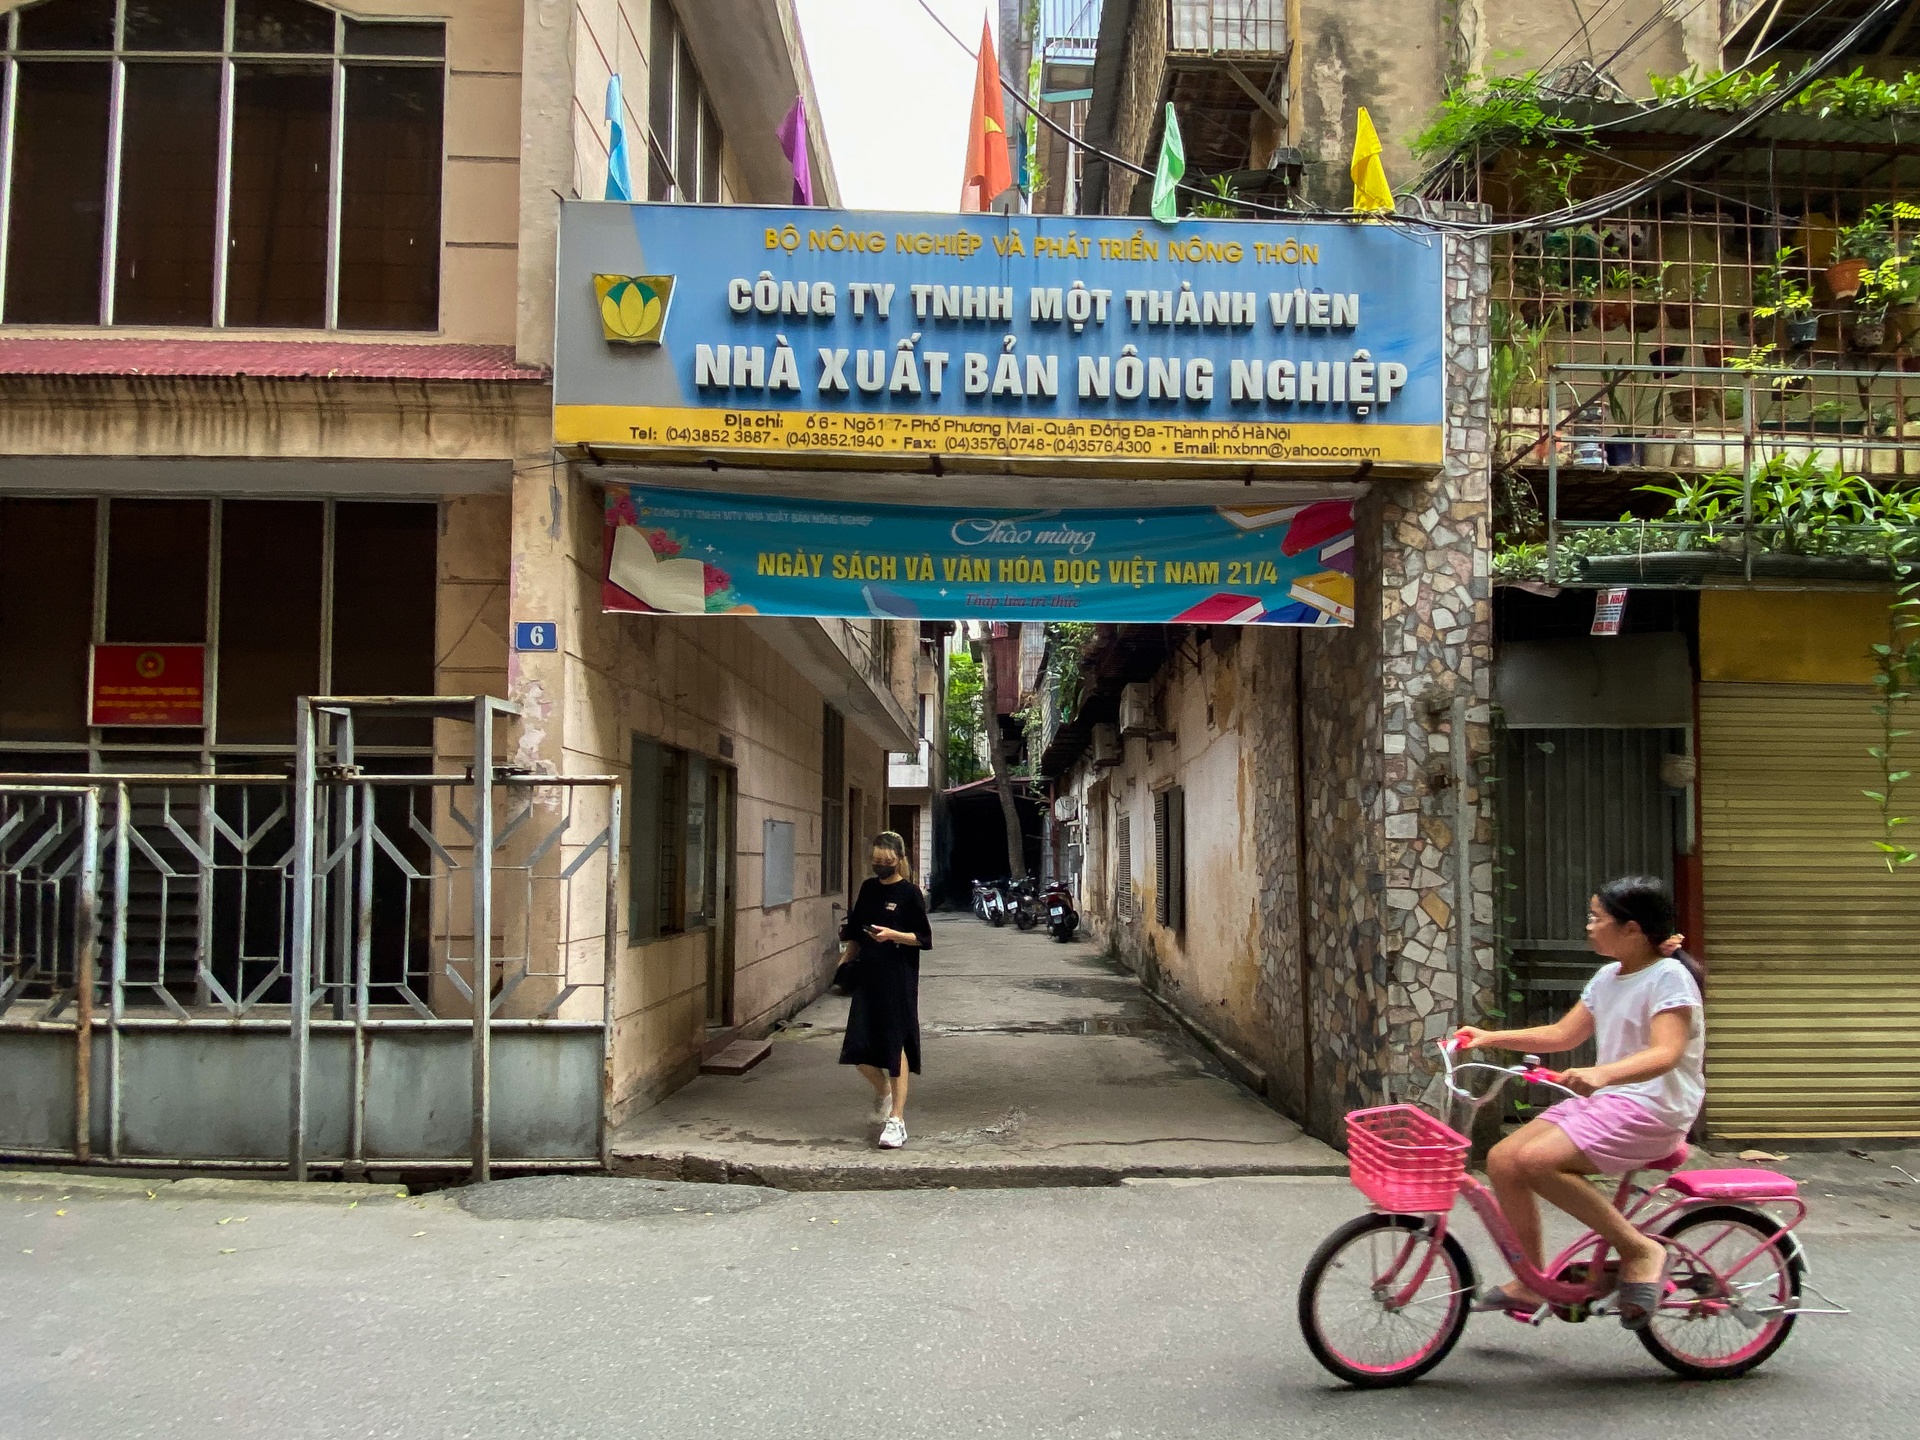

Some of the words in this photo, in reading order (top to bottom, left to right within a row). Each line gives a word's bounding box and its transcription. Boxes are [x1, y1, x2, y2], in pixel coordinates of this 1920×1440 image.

[765, 223, 800, 256] BỘ
[808, 224, 887, 253] NÔNG
[896, 228, 983, 261] NGHIỆP
[993, 229, 1025, 257] VÀ
[1033, 230, 1091, 259] PHÁT
[1098, 228, 1159, 261] TRIỂN
[1168, 235, 1244, 263] NÔNG
[1254, 237, 1319, 265] THÔN
[728, 271, 837, 316] CÔNG
[849, 283, 896, 318] TY
[910, 285, 1013, 321] TNHH
[1031, 280, 1112, 333] MỘT
[695, 334, 800, 391] NHÀ
[817, 332, 949, 395] XUẤT
[964, 335, 1059, 397] BẢN
[1078, 344, 1214, 401] NÔNG
[1231, 349, 1408, 416] NGHIỆP
[629, 426, 657, 440] Tel:
[786, 432, 884, 447] (04)3852.1940
[903, 436, 936, 449] Fax:
[1174, 441, 1219, 454] Email:
[1223, 443, 1381, 459] nxbnn@yahoo.com.vn
[724, 413, 751, 430] Địa
[755, 413, 783, 428] chỉ:
[819, 416, 828, 429] 6
[844, 417, 875, 433] Ngõ
[911, 417, 940, 433] Phố
[944, 420, 1001, 437] Phương
[1212, 423, 1239, 441] phố
[951, 518, 1032, 546] Chào
[1034, 523, 1096, 555] mừng
[757, 547, 824, 578] NGÀY
[832, 550, 897, 581] SÁCH
[904, 552, 935, 581] VÀ
[943, 554, 991, 583] VĂN
[999, 555, 1047, 584] HÓA
[1053, 559, 1101, 589] ĐỌC
[1108, 555, 1157, 588] VIỆT
[1164, 561, 1219, 584] NAM
[1227, 561, 1278, 584] 21/4
[530, 625, 544, 646] 6
